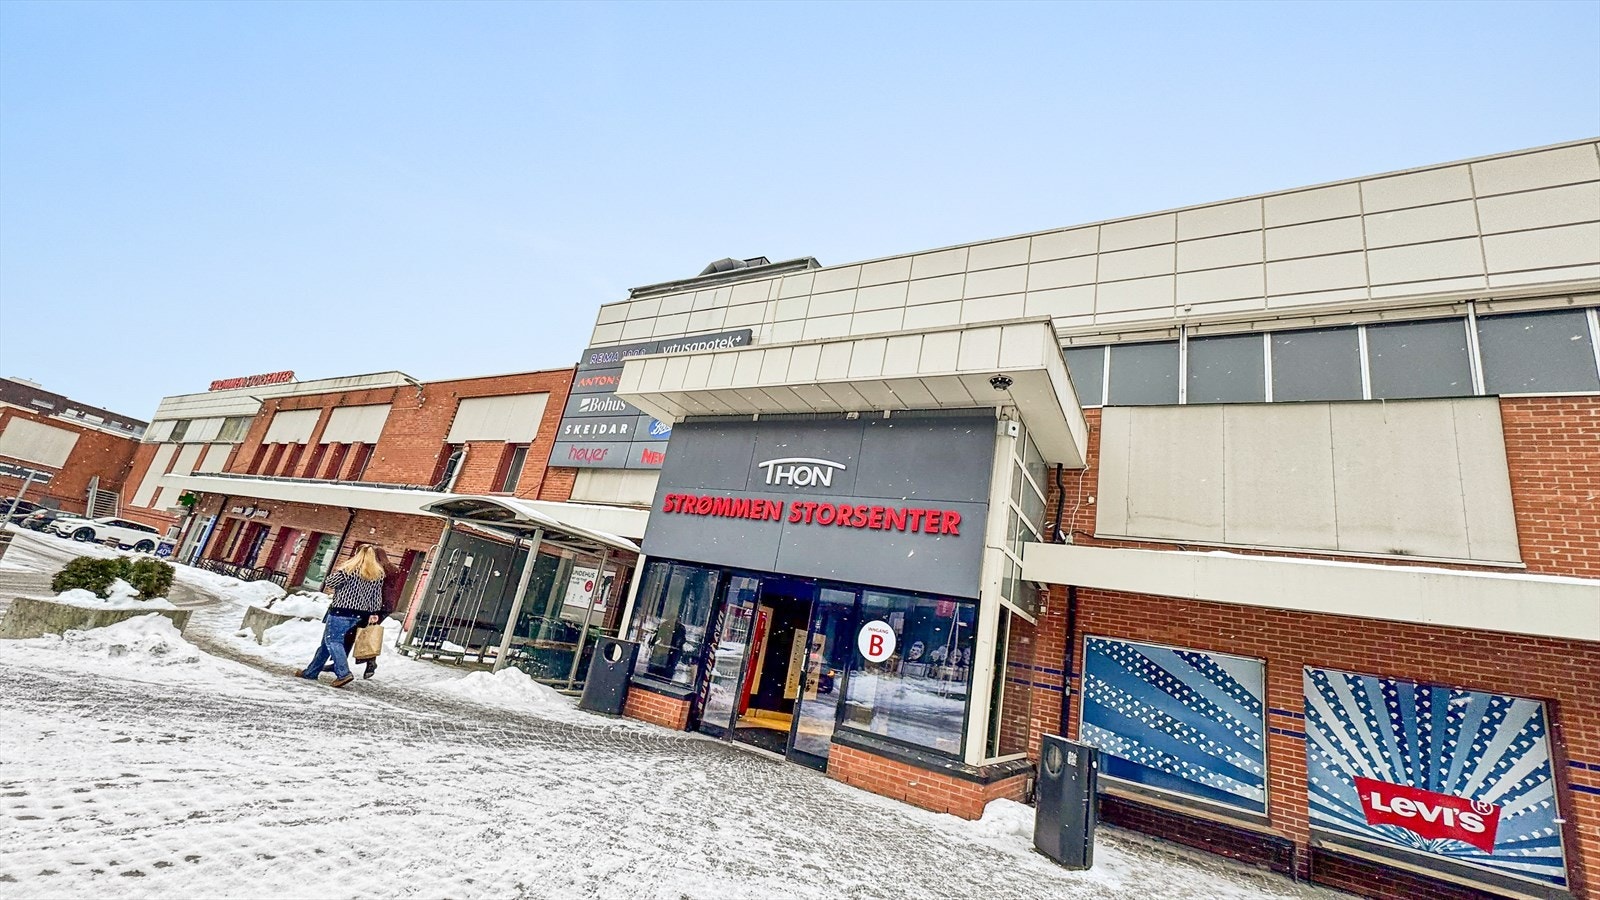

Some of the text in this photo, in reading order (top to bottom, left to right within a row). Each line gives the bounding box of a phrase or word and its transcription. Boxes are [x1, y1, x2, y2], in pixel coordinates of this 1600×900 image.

[589, 351, 619, 365] REMA
[577, 375, 615, 388] ANTON
[588, 397, 626, 412] Bohus
[565, 423, 628, 435] SKEIDAR
[758, 457, 847, 488] THON
[663, 493, 962, 536] STRØMMEN STORSENTER
[868, 634, 884, 657] B
